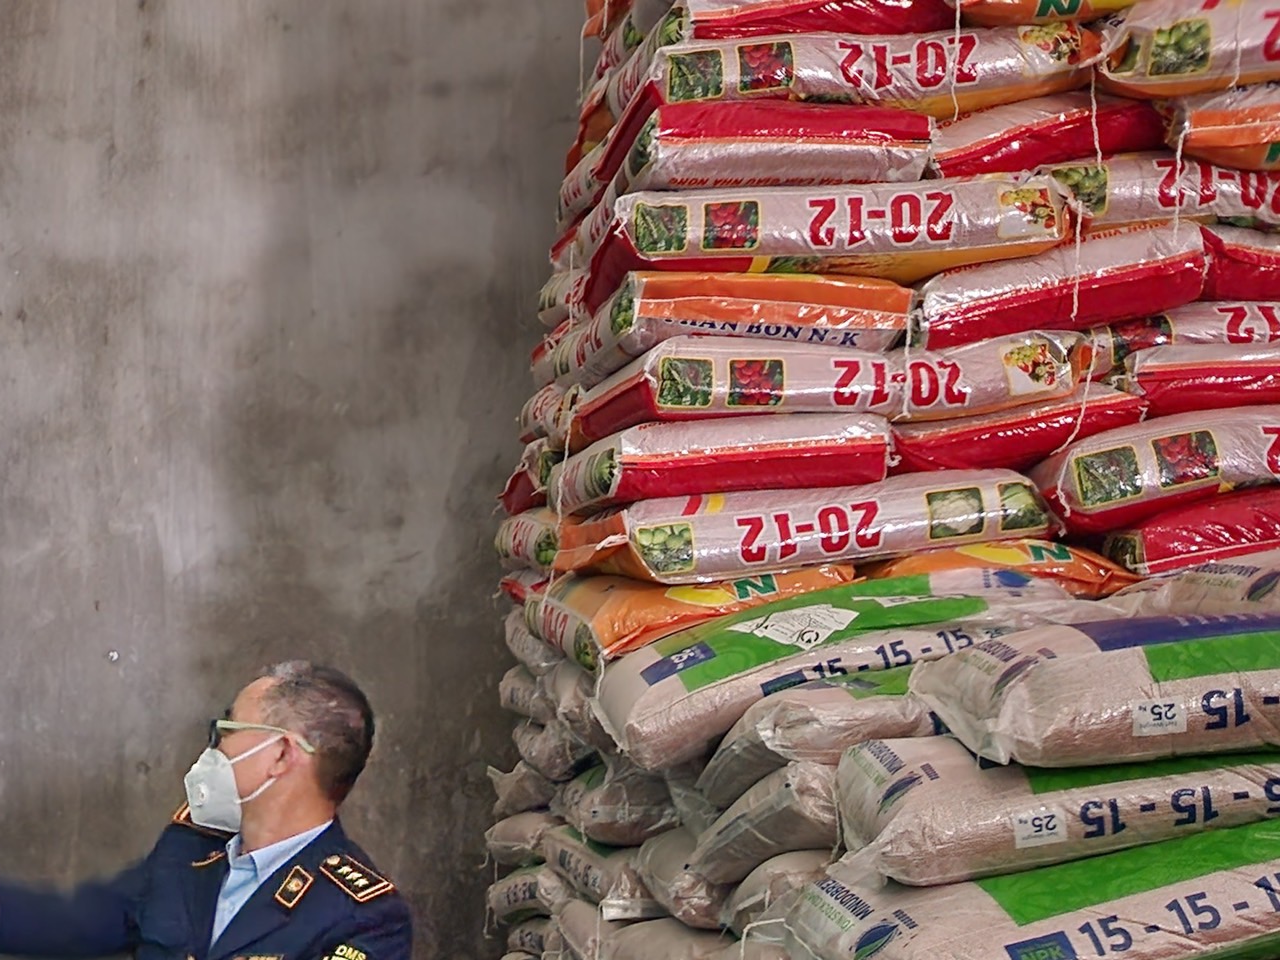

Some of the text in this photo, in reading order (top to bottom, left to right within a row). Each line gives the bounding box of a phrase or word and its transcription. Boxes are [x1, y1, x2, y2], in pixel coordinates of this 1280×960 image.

[838, 33, 978, 90] 20-12
[809, 192, 955, 247] 20-12
[808, 328, 860, 346] N-K
[833, 359, 969, 406] 20-12
[737, 500, 881, 562] 20-12
[875, 639, 913, 669] 15
[937, 628, 974, 654] 15
[1150, 703, 1176, 721] 25
[1201, 688, 1251, 730] 15
[1031, 814, 1057, 833] 25
[1079, 786, 1219, 839] 15 15
[1078, 914, 1133, 957] 15
[1165, 891, 1221, 935] 15
